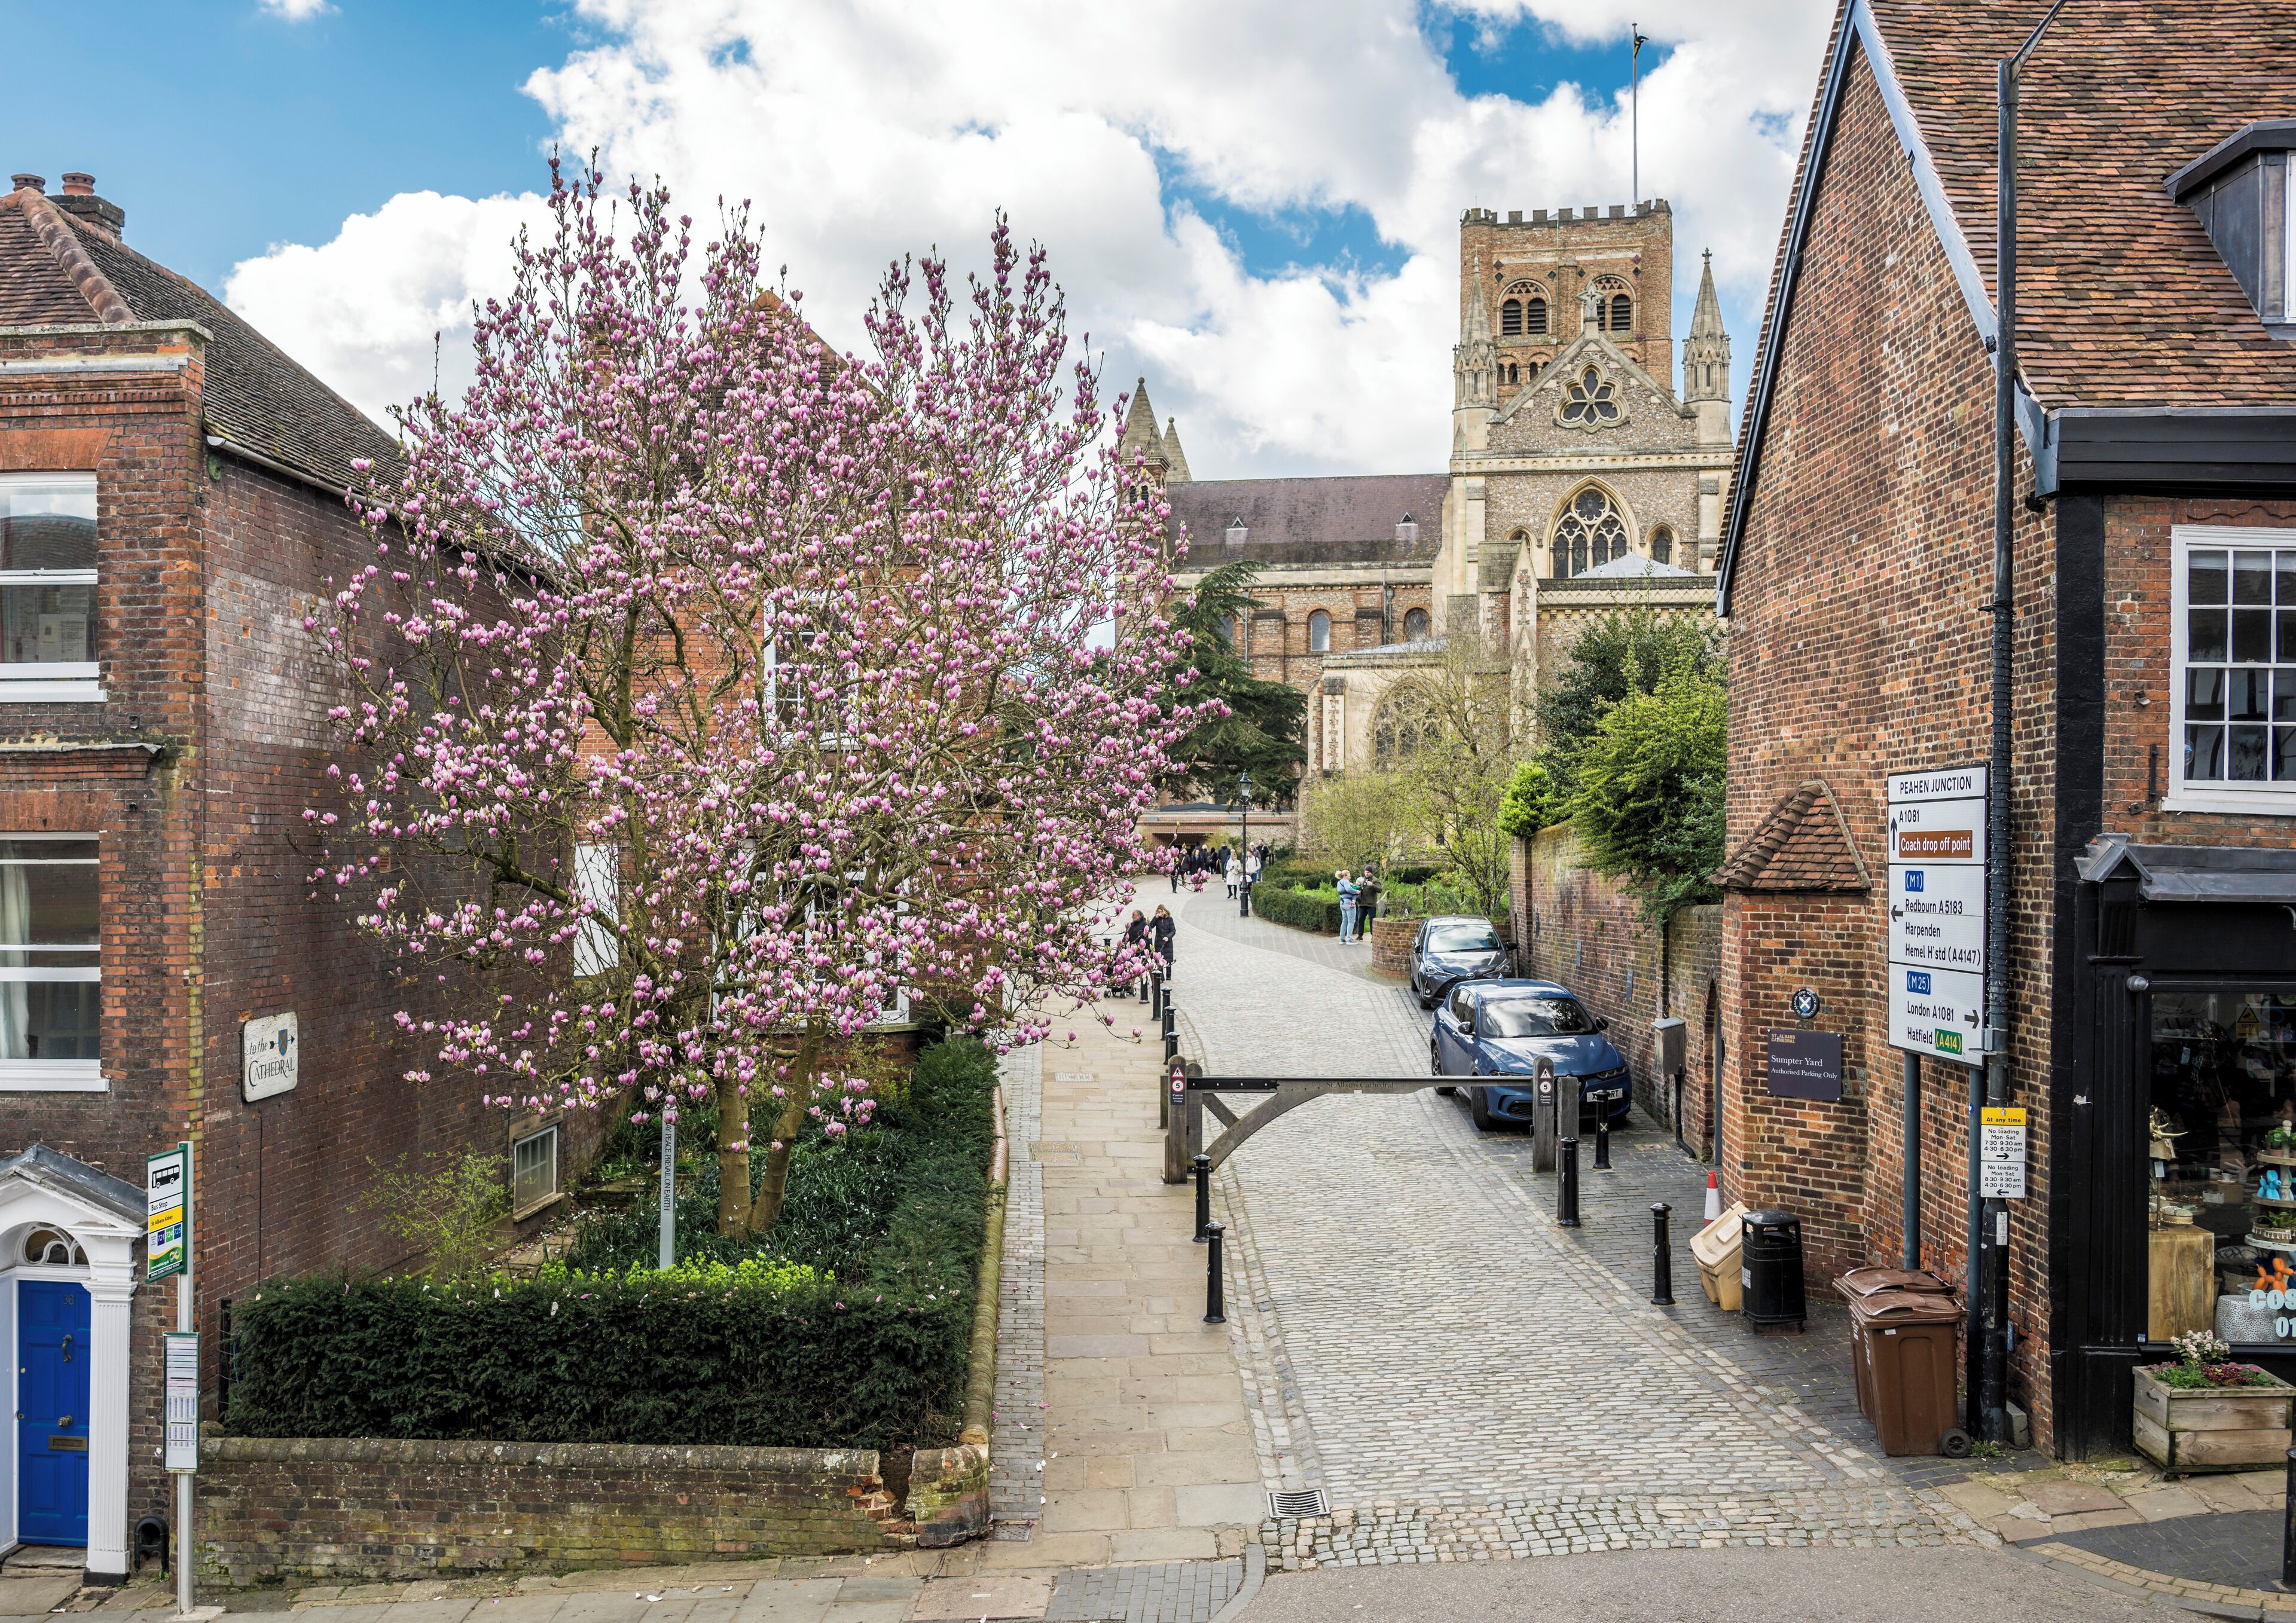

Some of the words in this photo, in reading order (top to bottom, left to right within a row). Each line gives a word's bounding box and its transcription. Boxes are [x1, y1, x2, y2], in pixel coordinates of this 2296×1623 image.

[1900, 780, 1929, 794] PEAHEN
[1931, 775, 1971, 792] JUNCTION
[1899, 809, 1919, 823] A1081
[1901, 838, 1921, 851] Coach
[1922, 838, 1938, 853] drop
[1940, 837, 1950, 851] off
[1952, 836, 1970, 853] point
[1906, 873, 1923, 890] (M1)
[1905, 898, 1937, 913] Redbourn
[1939, 900, 1962, 915] A5183
[1905, 922, 1940, 937] Harpenden
[1905, 943, 1925, 959] Hemel
[1928, 945, 1946, 961] H'std
[1948, 946, 1980, 967] (A4147)
[1908, 974, 1930, 992] (M25)
[1907, 1001, 1930, 1017] London
[1932, 1005, 1954, 1022] A1081
[250, 1041, 257, 1055] to
[258, 1038, 268, 1053] the
[1907, 1026, 1932, 1044] Hatfield
[1935, 1031, 1962, 1052] (A414)
[1771, 1055, 1803, 1066] Sumpter
[1805, 1057, 1822, 1066] Yard
[249, 1057, 295, 1087] CATHEDRAL
[1771, 1068, 1800, 1076] Authorised
[1801, 1070, 1822, 1078] Parking
[1823, 1072, 1837, 1080] Only
[664, 1179, 671, 1188] ON
[63, 1294, 74, 1305] 36
[2276, 1316, 2296, 1337] 01
